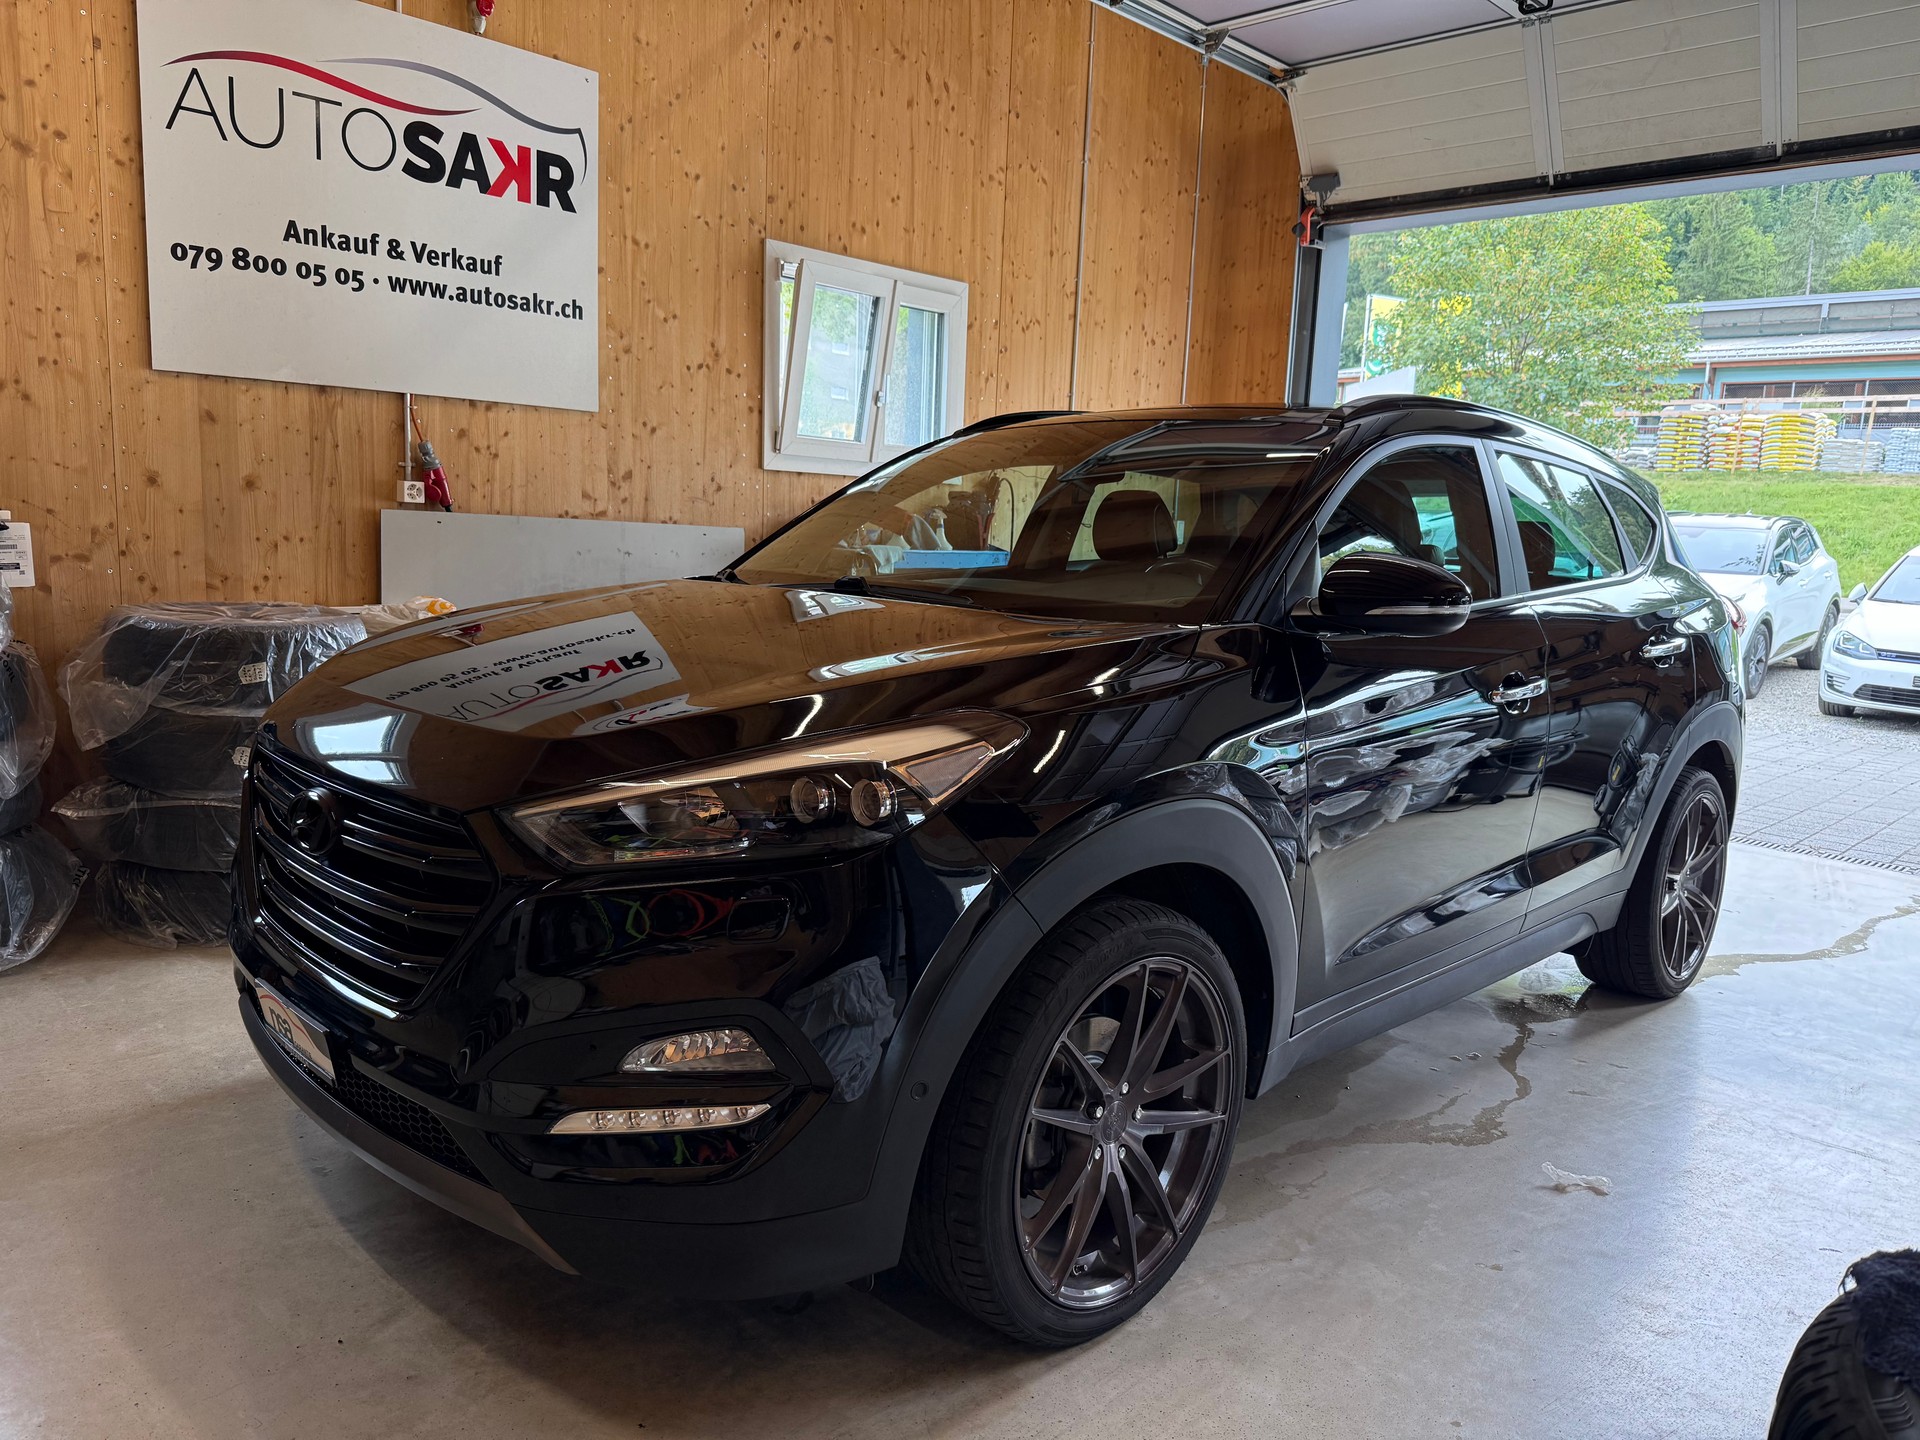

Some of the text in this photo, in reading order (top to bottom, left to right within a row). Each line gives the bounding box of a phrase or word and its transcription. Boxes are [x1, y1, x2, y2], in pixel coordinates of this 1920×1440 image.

[165, 67, 577, 214] AUTOSAKR
[170, 242, 223, 272] 079
[231, 247, 287, 276] 800
[295, 261, 327, 287] 05
[335, 267, 365, 292] 05
[387, 275, 584, 320] www.autosakr.ch
[283, 219, 503, 276] Ankauf & Verkauf
